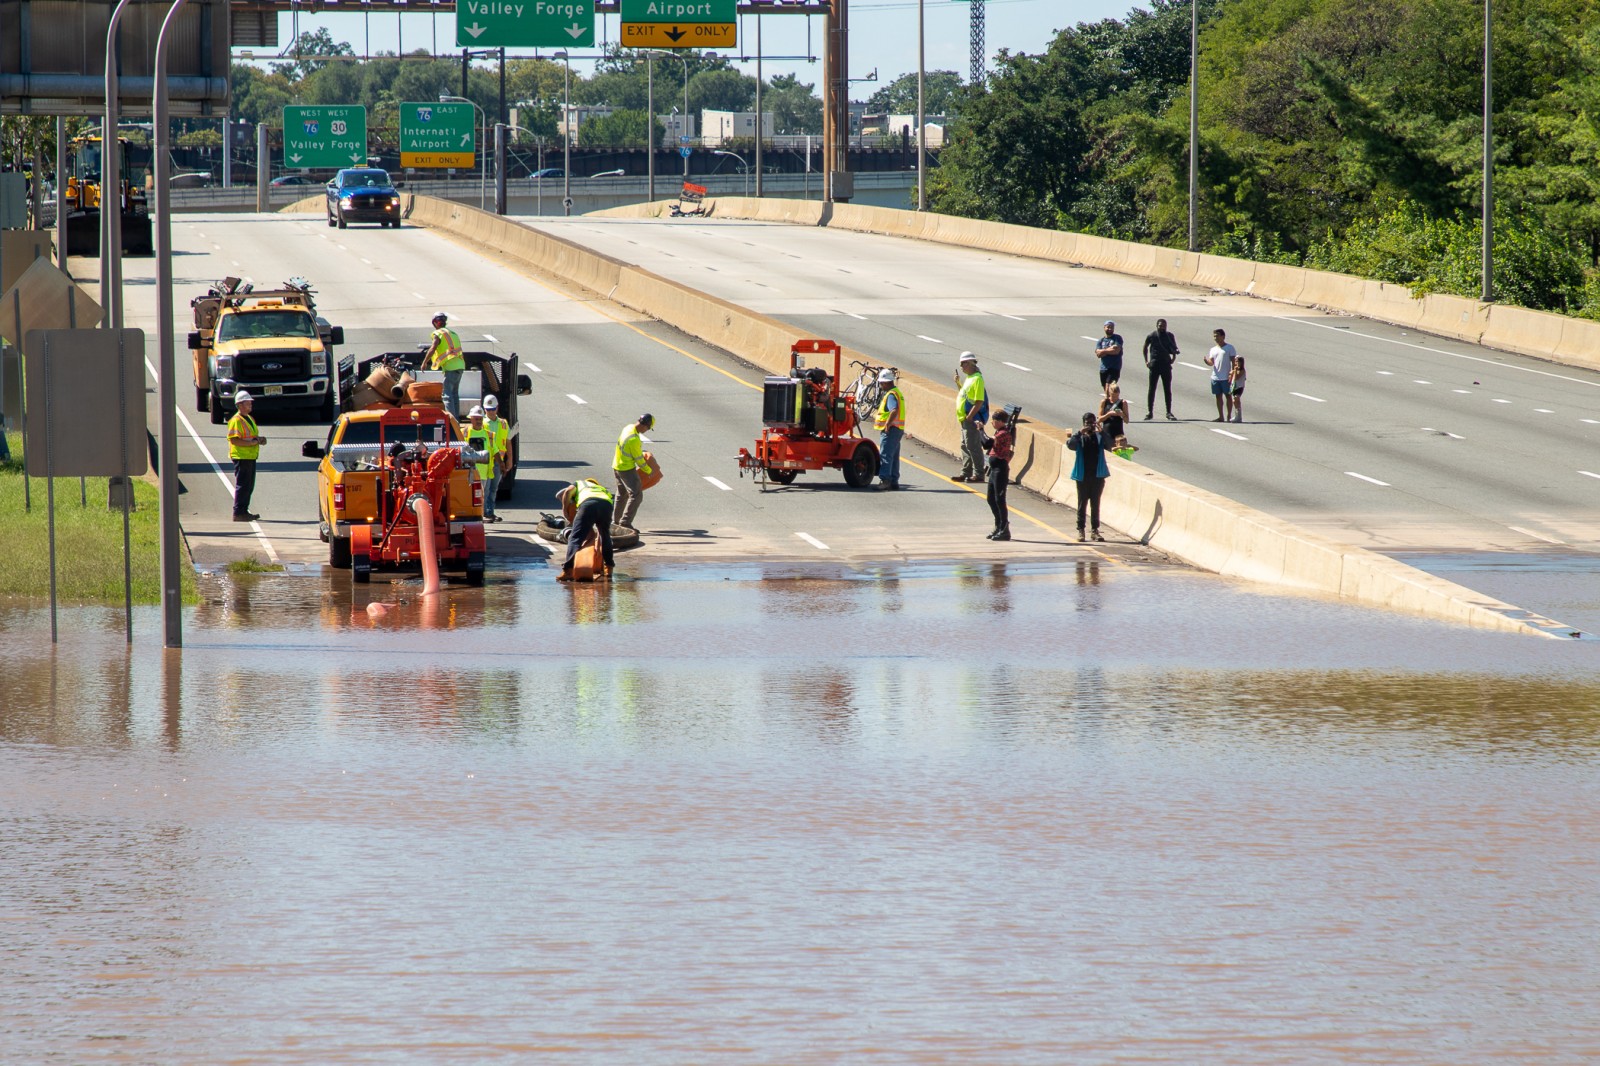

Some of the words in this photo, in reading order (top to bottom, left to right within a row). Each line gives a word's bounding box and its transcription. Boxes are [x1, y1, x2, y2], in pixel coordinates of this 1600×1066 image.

[468, 1, 524, 18] Valley
[536, 2, 584, 19] Forge
[646, 2, 712, 17] Airport
[627, 26, 655, 36] EXIT
[694, 26, 730, 36] ONLY
[418, 111, 431, 120] 76
[304, 123, 317, 133] 76
[332, 123, 346, 132] 30
[290, 140, 325, 151] Valley
[331, 140, 361, 151] Forge
[410, 140, 450, 149] Airport
[682, 146, 690, 155] 76
